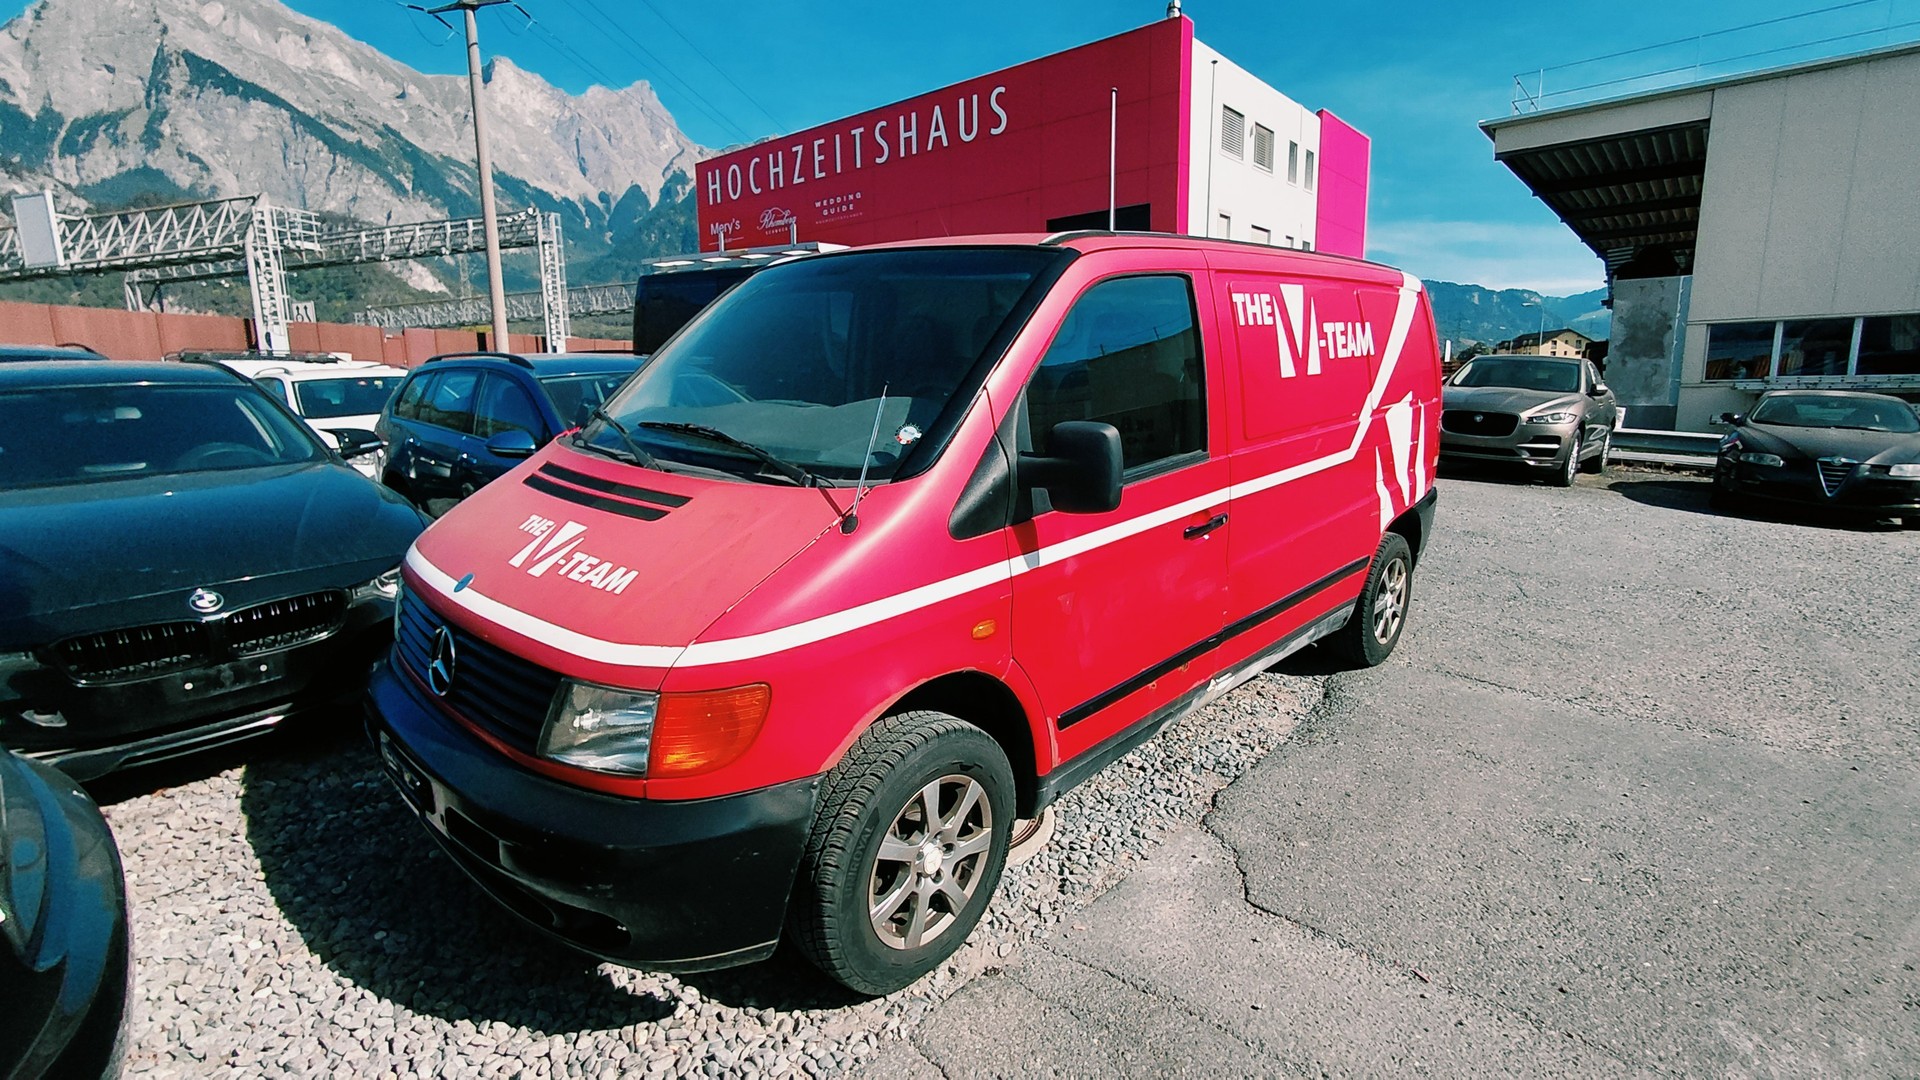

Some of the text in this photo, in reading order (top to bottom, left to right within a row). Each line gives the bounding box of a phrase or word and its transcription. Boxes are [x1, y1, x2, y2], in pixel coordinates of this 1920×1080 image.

[707, 86, 1008, 205] HOCHZEITSHAUS
[814, 191, 862, 208] WEDDING
[822, 203, 854, 216] GUIDE
[710, 217, 741, 236] Mery's
[1232, 293, 1274, 326] THE
[518, 514, 555, 537] THE
